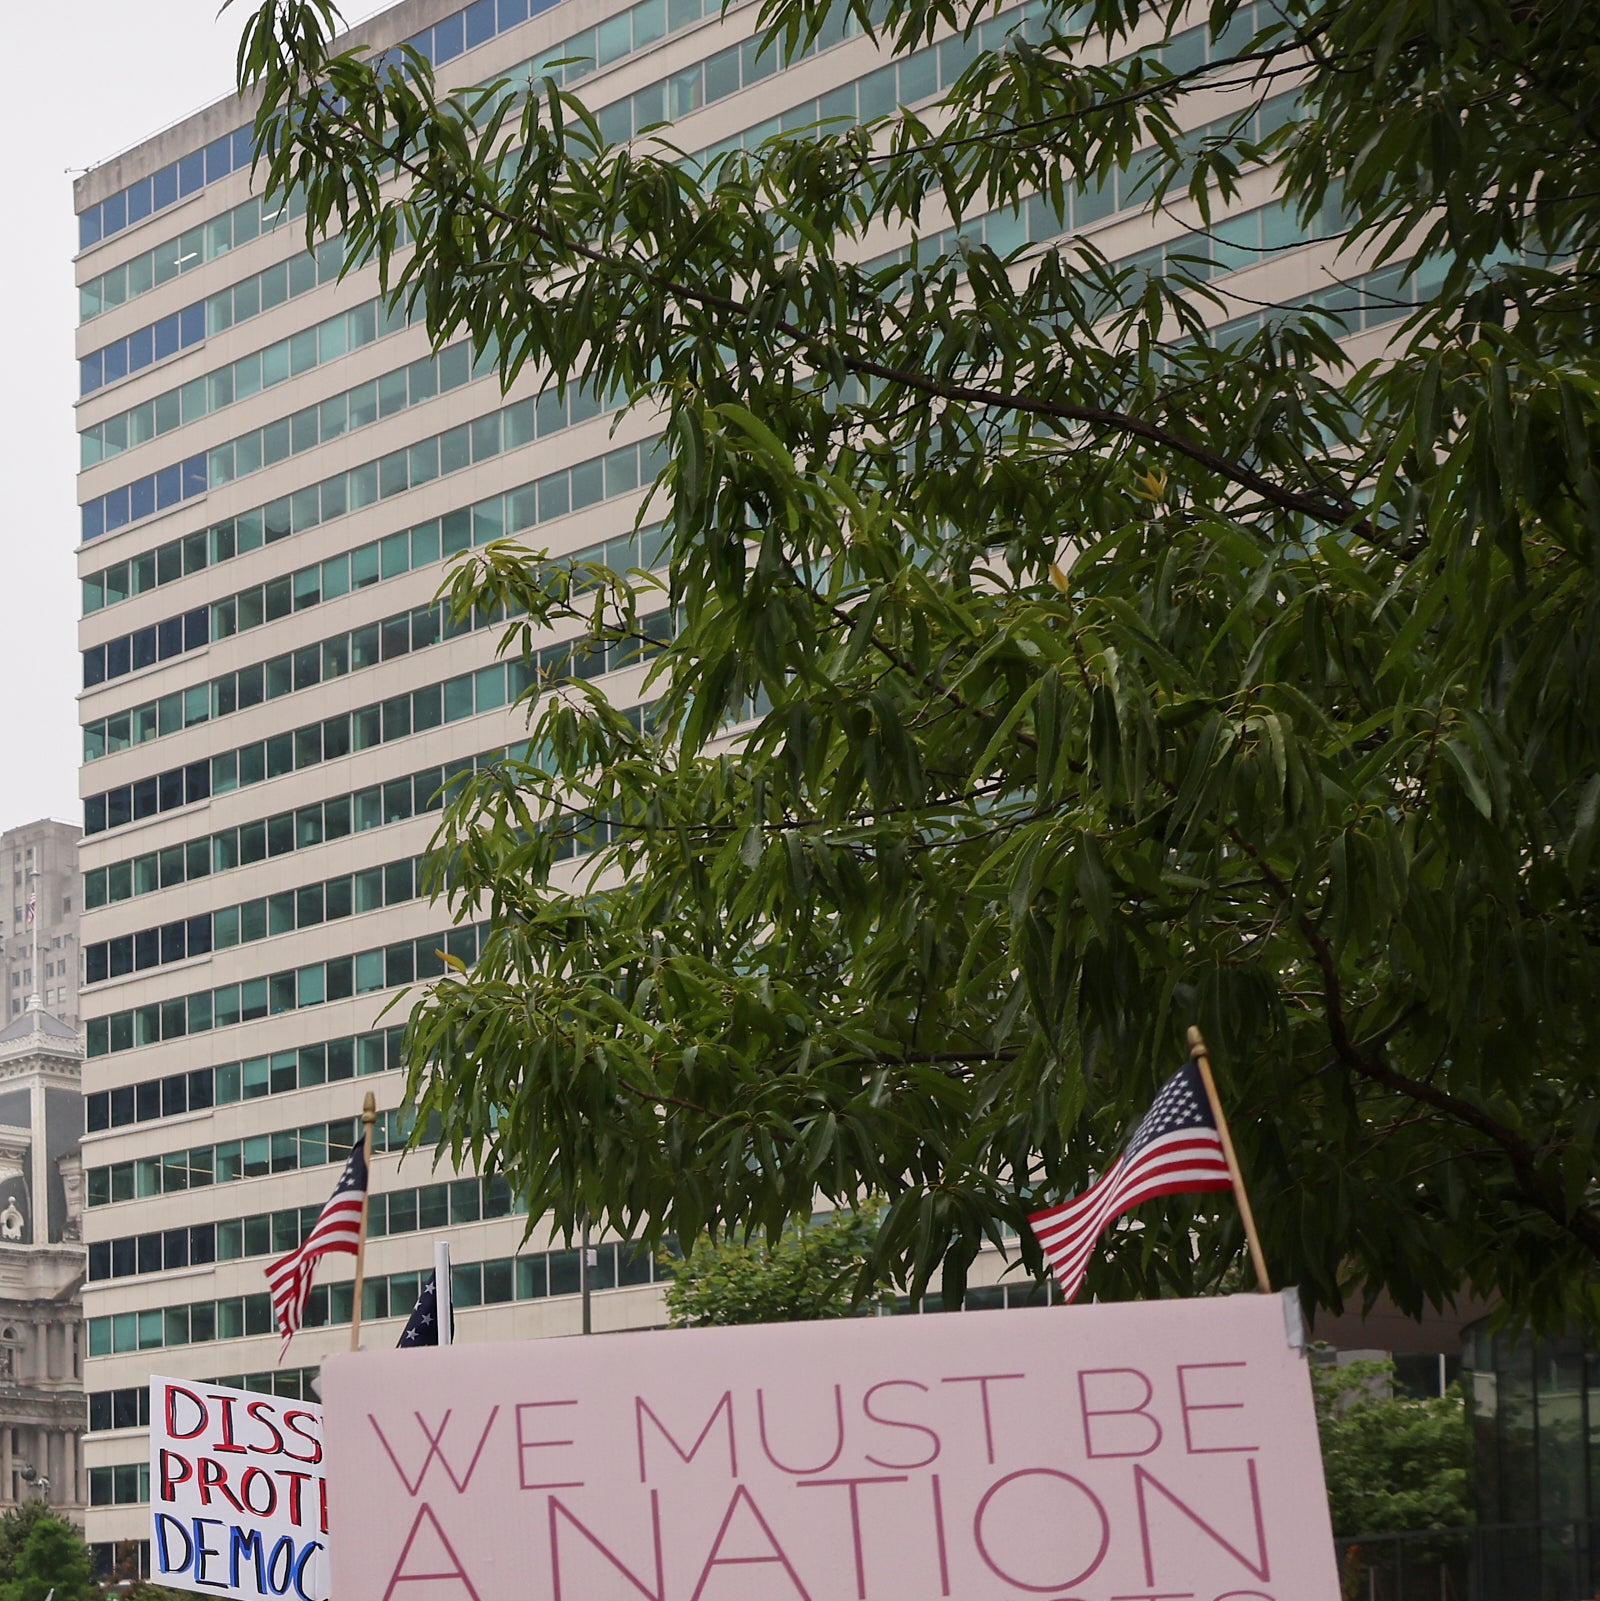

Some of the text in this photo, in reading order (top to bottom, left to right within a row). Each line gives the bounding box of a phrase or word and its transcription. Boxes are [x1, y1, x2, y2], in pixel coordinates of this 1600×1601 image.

[367, 1360, 1260, 1497] WE MUST BE
